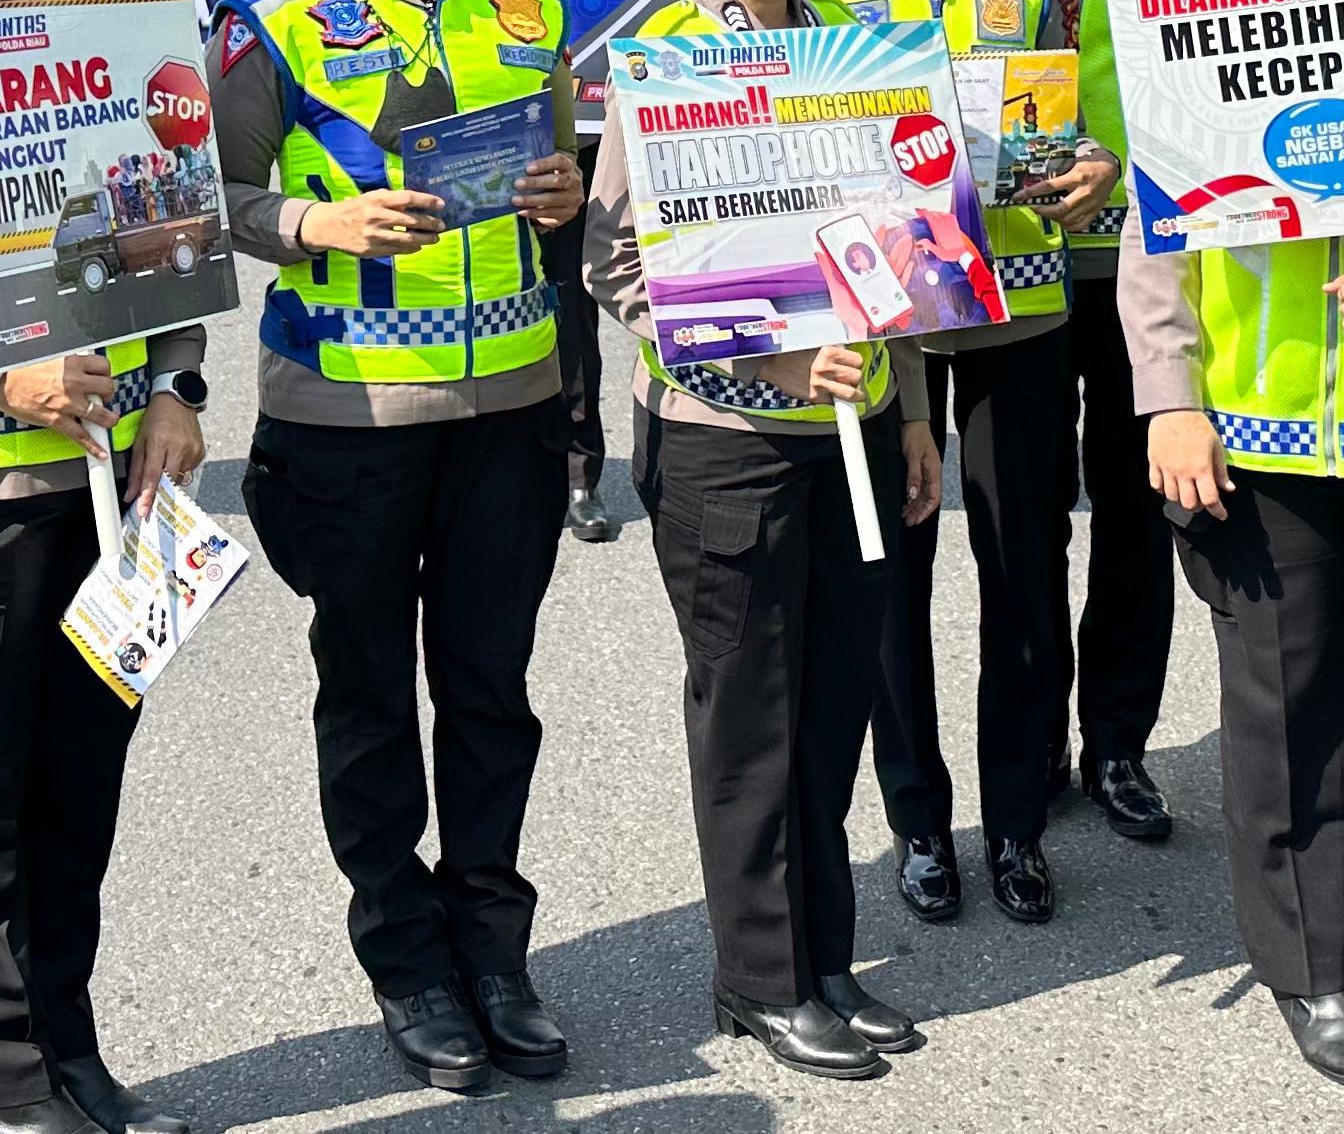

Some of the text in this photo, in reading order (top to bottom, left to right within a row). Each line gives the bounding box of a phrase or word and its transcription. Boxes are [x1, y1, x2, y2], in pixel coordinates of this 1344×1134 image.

[26, 37, 46, 48] RIAU
[693, 45, 786, 66] DITLANTAS
[735, 64, 786, 76] POLDA RIAU
[56, 97, 139, 130] BARANG
[152, 90, 206, 122] STOP
[775, 86, 931, 124] MENGGUNAKAN
[1290, 125, 1313, 140] GK
[646, 124, 888, 193] HANDPHONE
[893, 128, 953, 171] STOP
[1276, 150, 1336, 169] SANTAI
[659, 184, 844, 225] SAAT BERKENDARA
